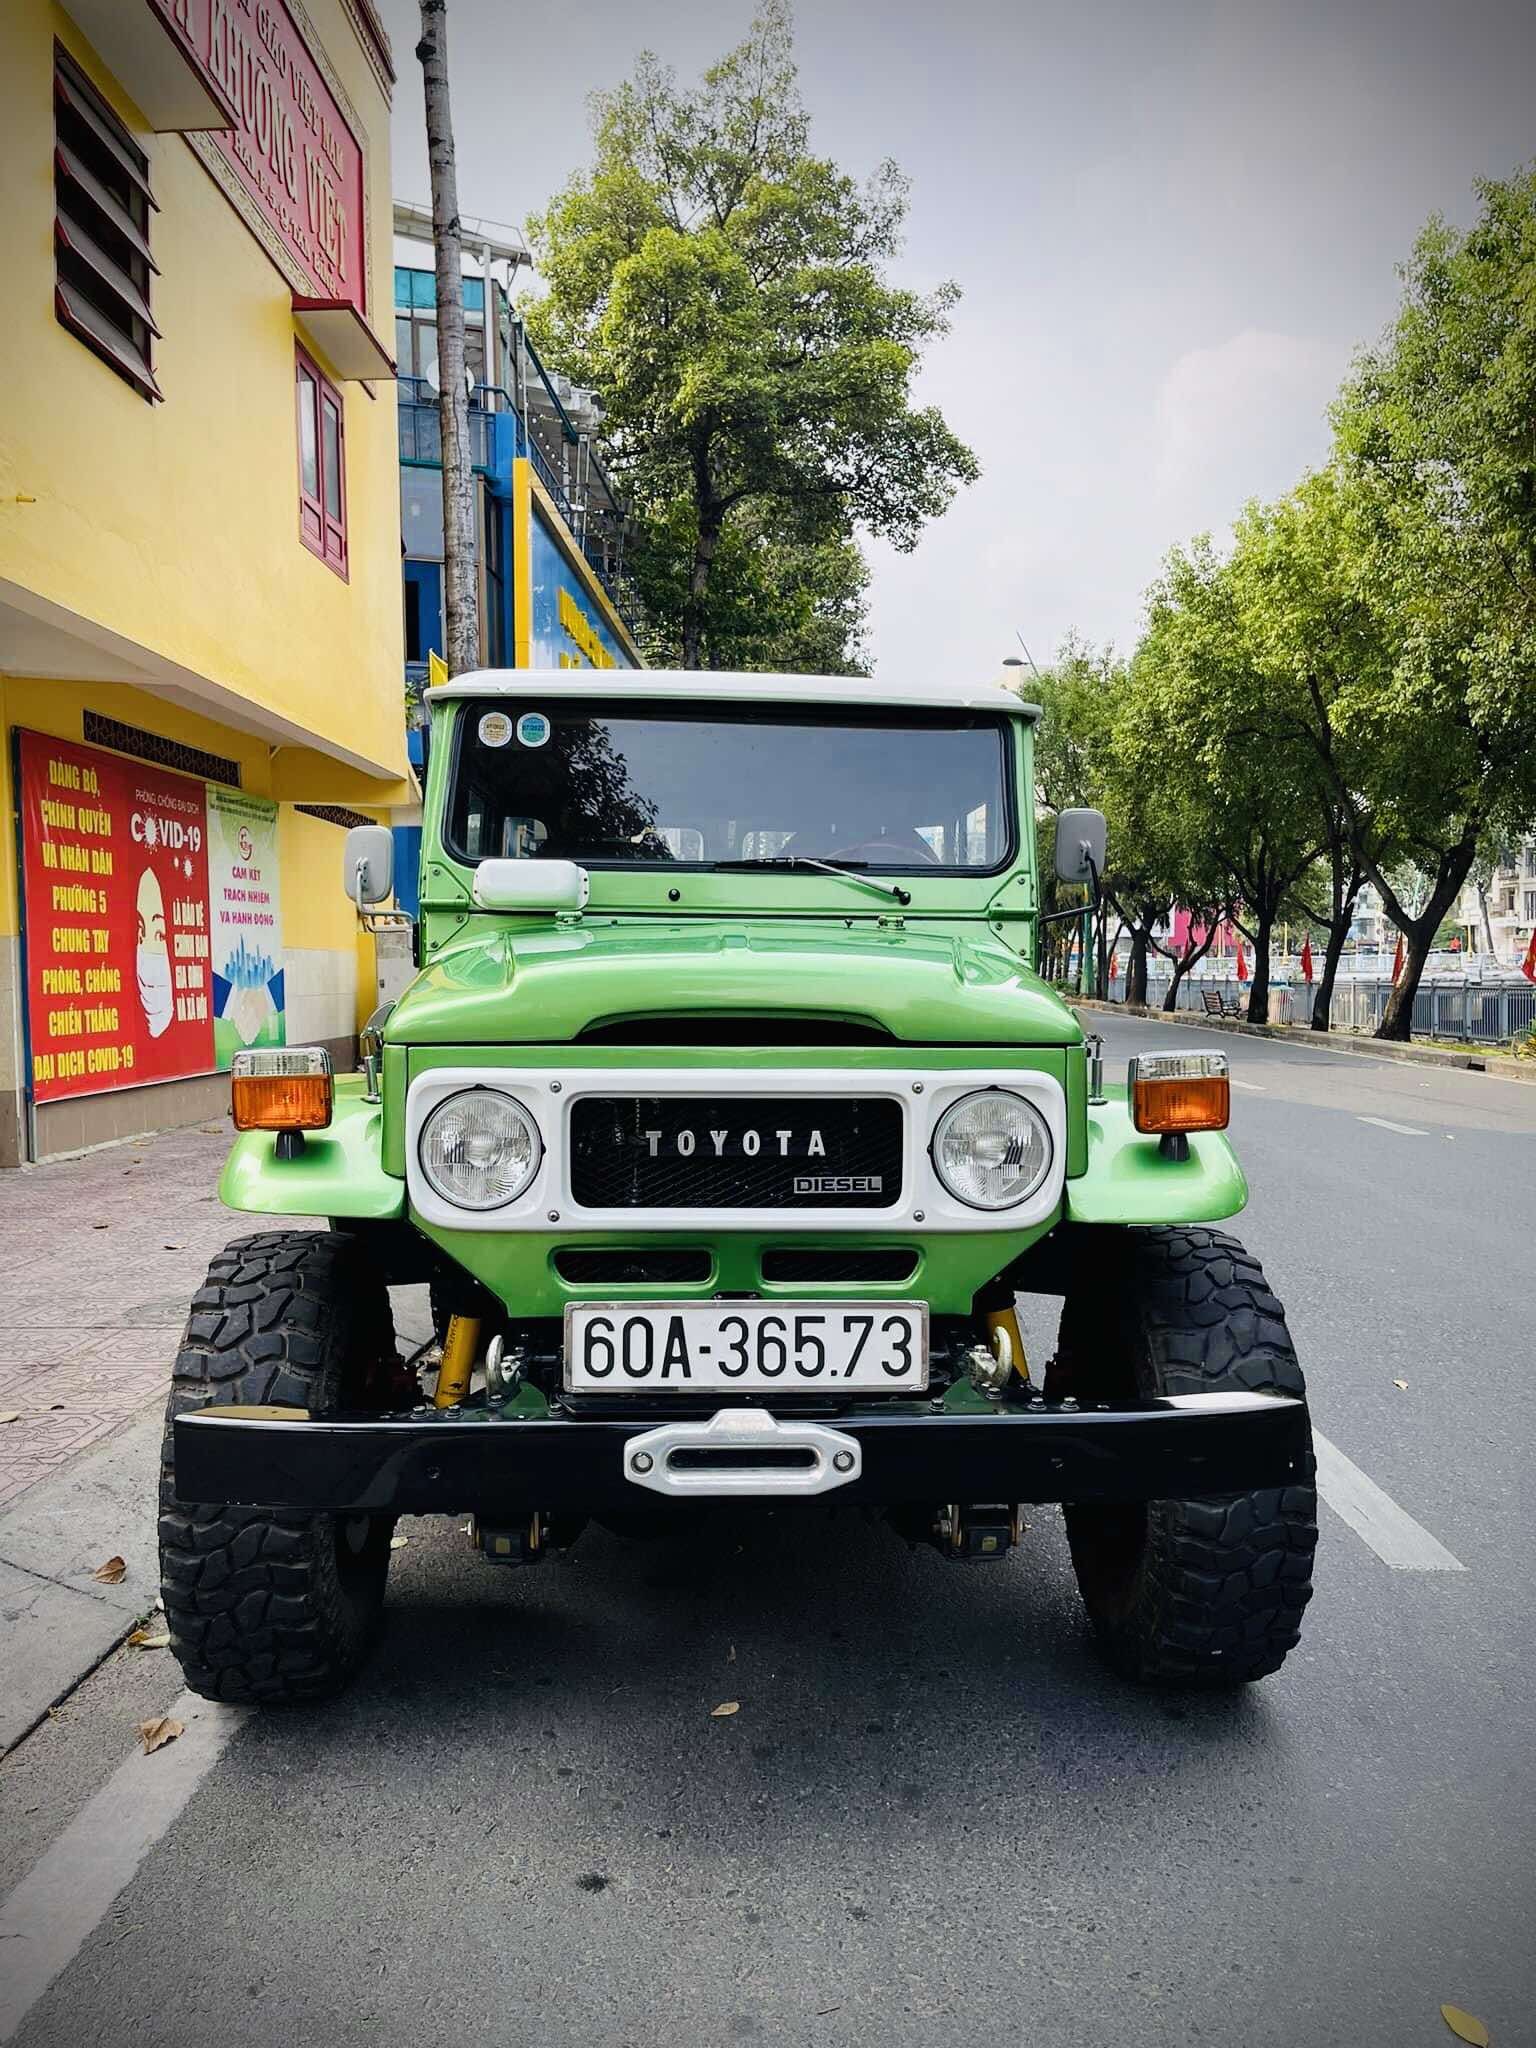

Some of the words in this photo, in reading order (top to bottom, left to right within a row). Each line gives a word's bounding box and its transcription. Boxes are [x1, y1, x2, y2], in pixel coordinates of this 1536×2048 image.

[303, 143, 347, 283] VIỆT
[41, 799, 75, 830] CHÍNH
[79, 803, 112, 837] QUYỀN
[42, 840, 58, 869] VÀ
[60, 844, 90, 873] NHÂN
[92, 848, 113, 875] DÂN
[52, 884, 97, 913] PHƯỜNG
[99, 890, 107, 914] 5
[52, 928, 90, 953] CHUNG
[92, 930, 109, 953] TAY
[42, 965, 84, 995] PHÒNG,
[85, 961, 121, 993] CHỐNG
[48, 1002, 82, 1036] CHIẾN
[84, 1002, 119, 1034] THẮNG
[34, 1054, 55, 1085] ĐẠI
[57, 1050, 85, 1081] DỊCH
[87, 1044, 134, 1073] COVID-19
[645, 1130, 826, 1157] TOYOTA
[796, 1177, 881, 1192] DIESEL
[584, 1315, 912, 1378] 60A-365.73
